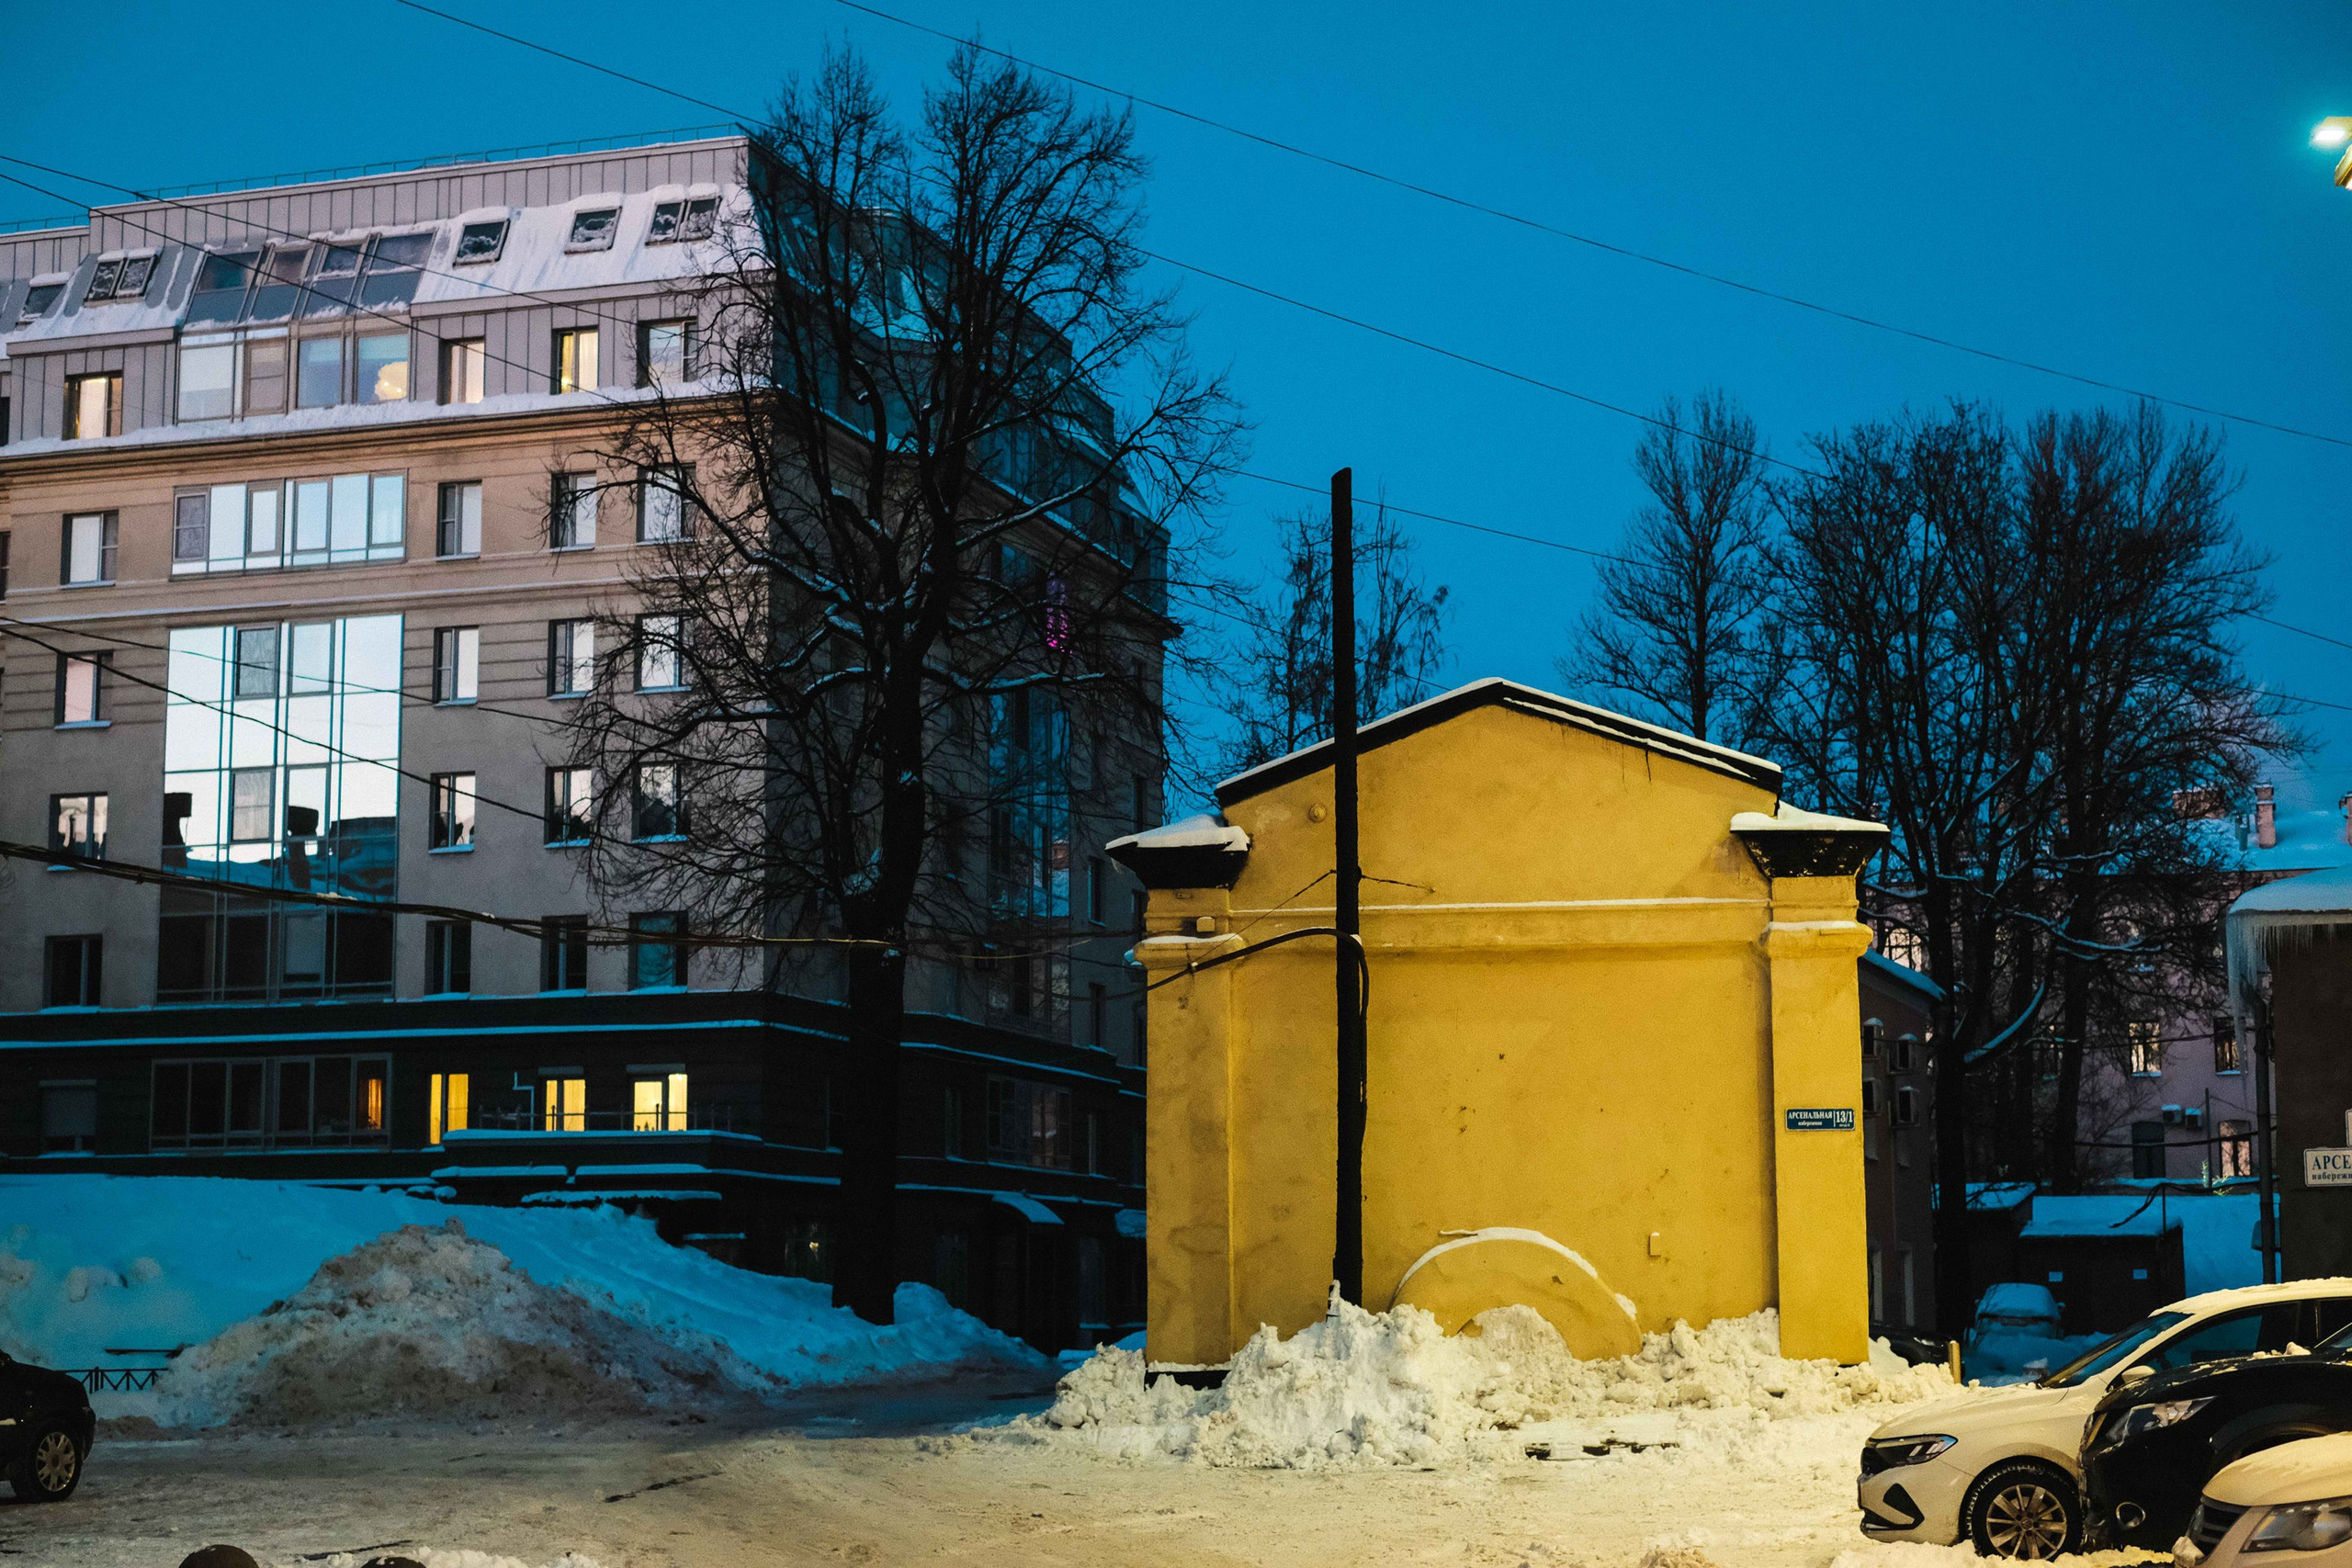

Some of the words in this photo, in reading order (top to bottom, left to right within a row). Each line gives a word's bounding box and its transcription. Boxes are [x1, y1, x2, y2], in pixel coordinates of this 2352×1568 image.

[1788, 1111, 1832, 1119] АРСЕНАЛЬНАЯ
[1836, 1111, 1853, 1123] 13/1
[2312, 1155, 2352, 1170] АРСЕ
